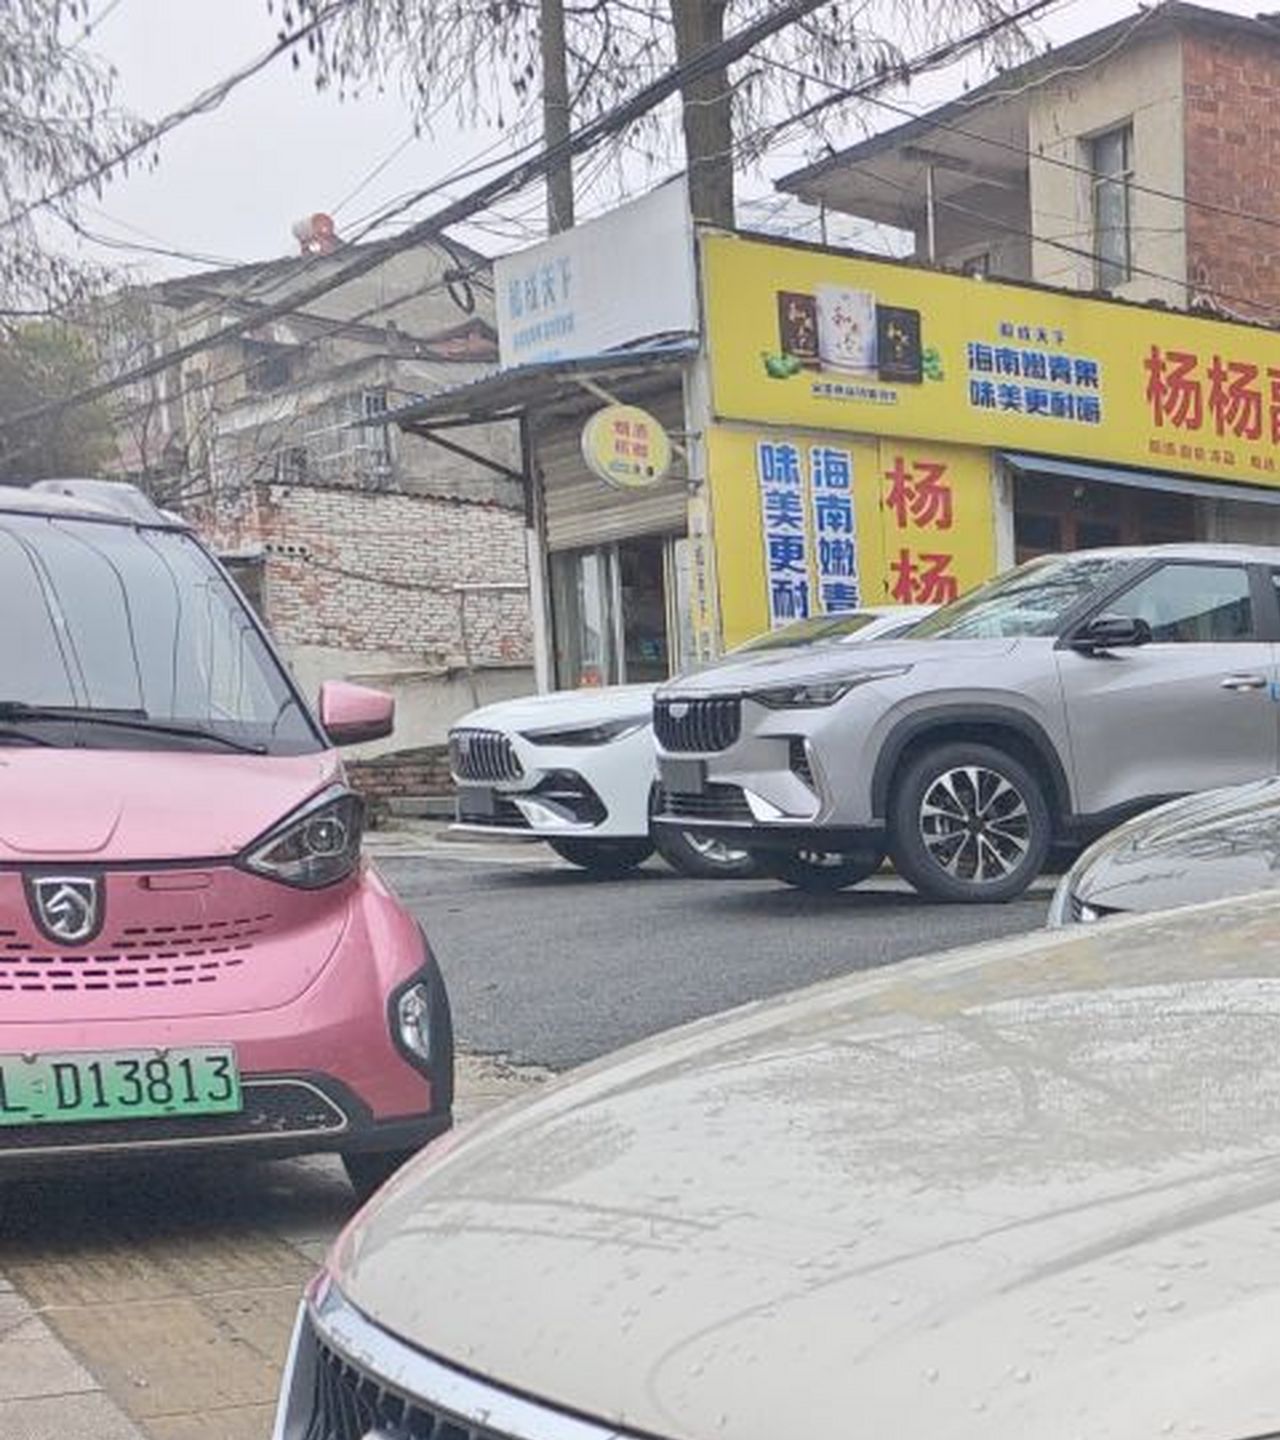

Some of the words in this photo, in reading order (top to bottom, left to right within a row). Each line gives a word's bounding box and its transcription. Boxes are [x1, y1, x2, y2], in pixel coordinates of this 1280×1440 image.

[760, 444, 809, 628] 味美更耐
[52, 1055, 234, 1110] D13813
